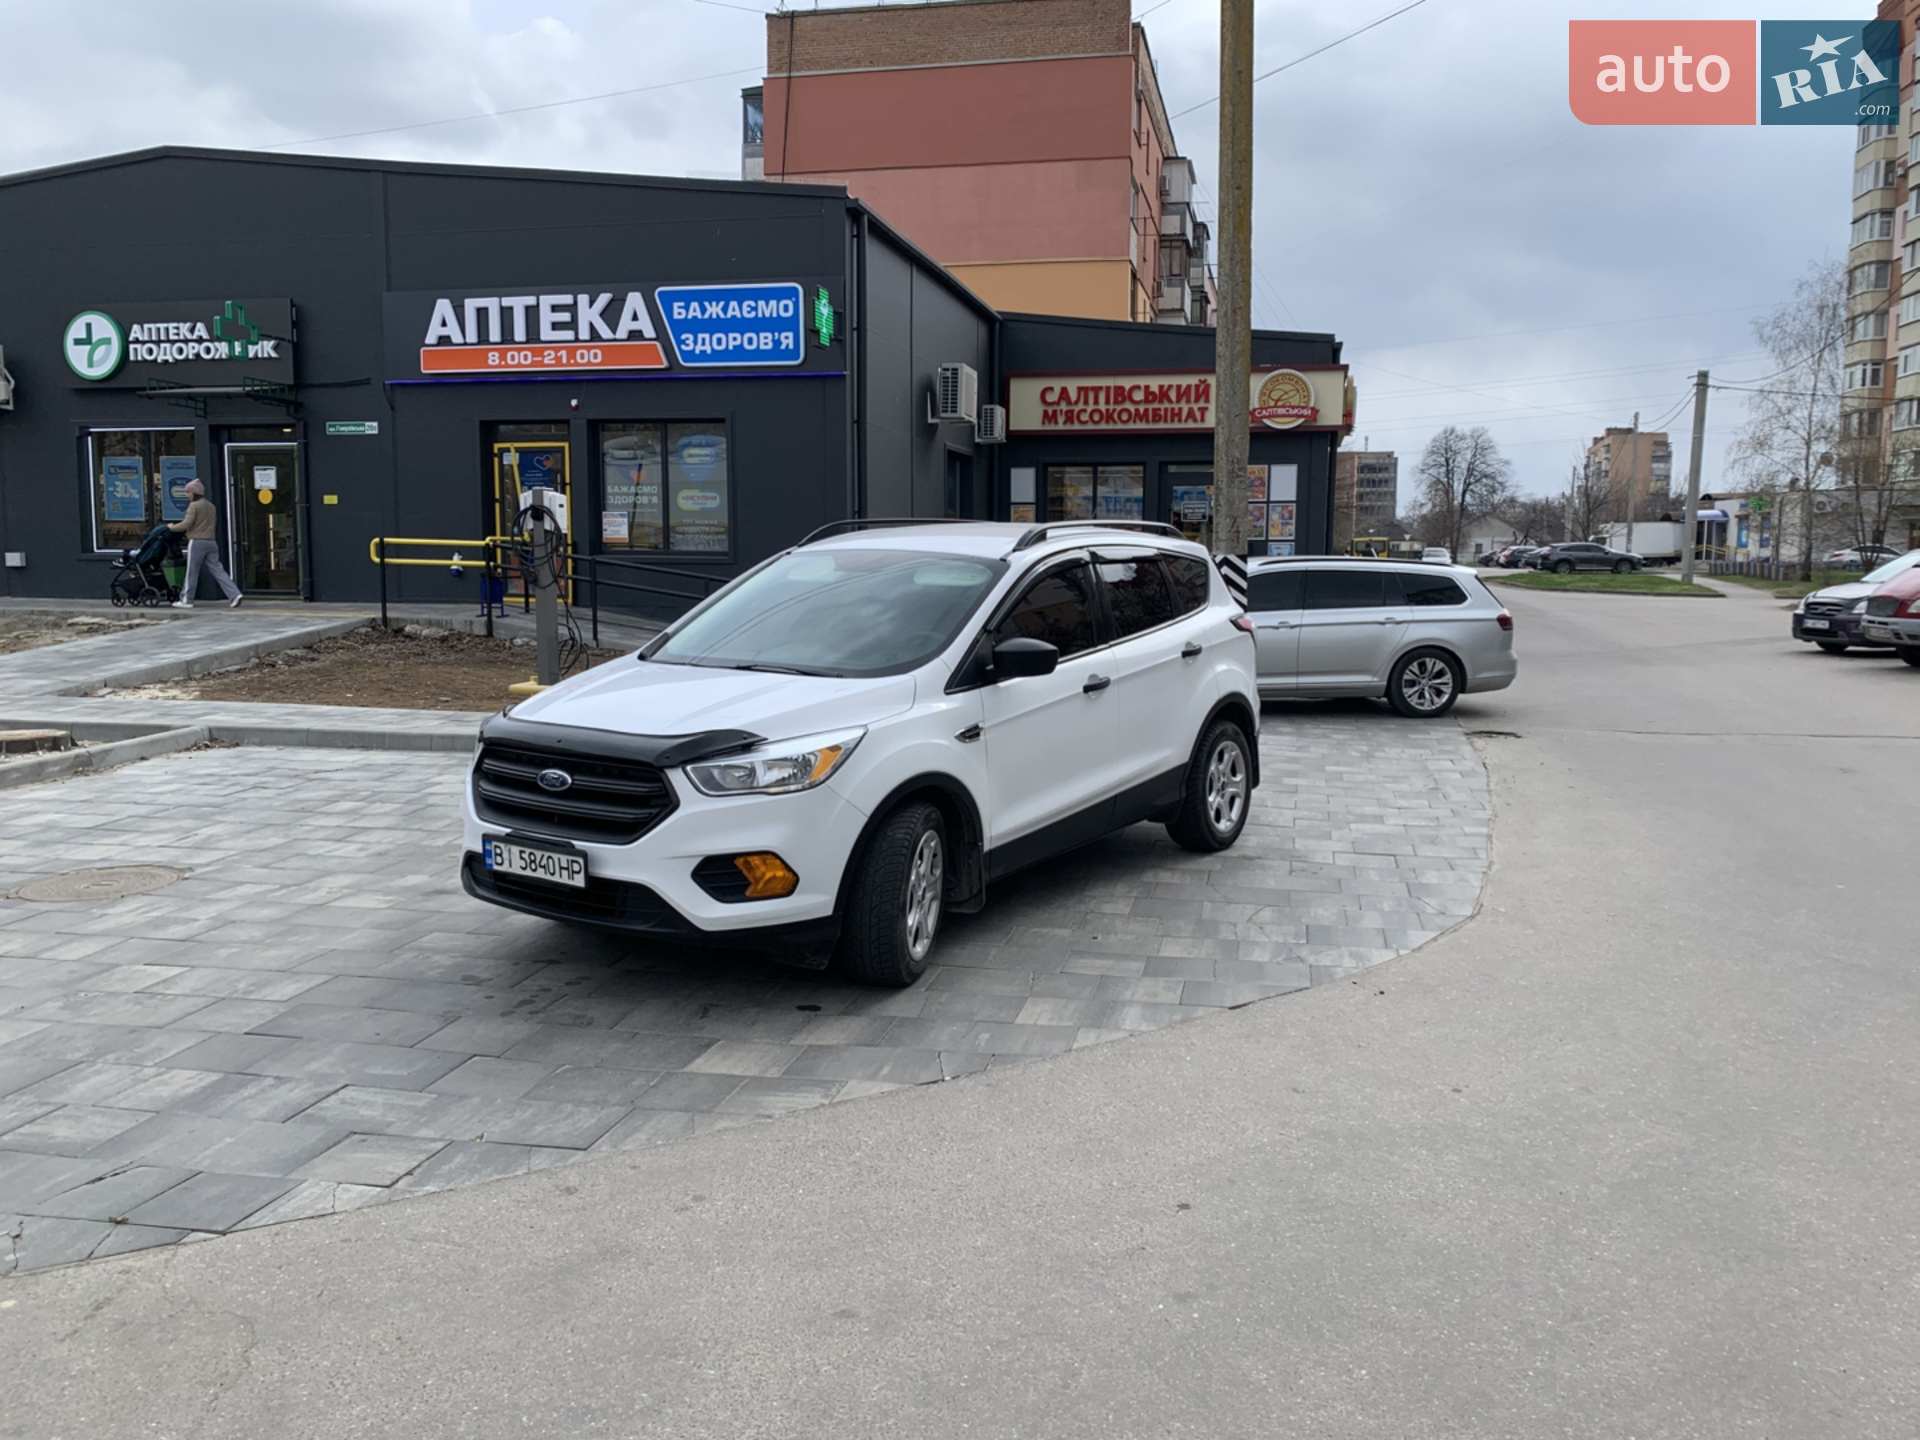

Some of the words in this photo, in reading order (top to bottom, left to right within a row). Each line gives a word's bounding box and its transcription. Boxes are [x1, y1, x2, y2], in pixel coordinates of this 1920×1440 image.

[424, 291, 658, 345] АПТЕКА
[672, 299, 794, 320] БАЖАЄМО
[128, 322, 211, 341] АПТЕКА
[680, 331, 794, 355] ЗДОРОВ'Я
[1039, 378, 1212, 407] САЛТІВСЬКИЙ
[1041, 406, 1210, 426] М'ЯСОКОМБІНАТ
[1254, 406, 1313, 418] САЛТІВСЬКИЙ
